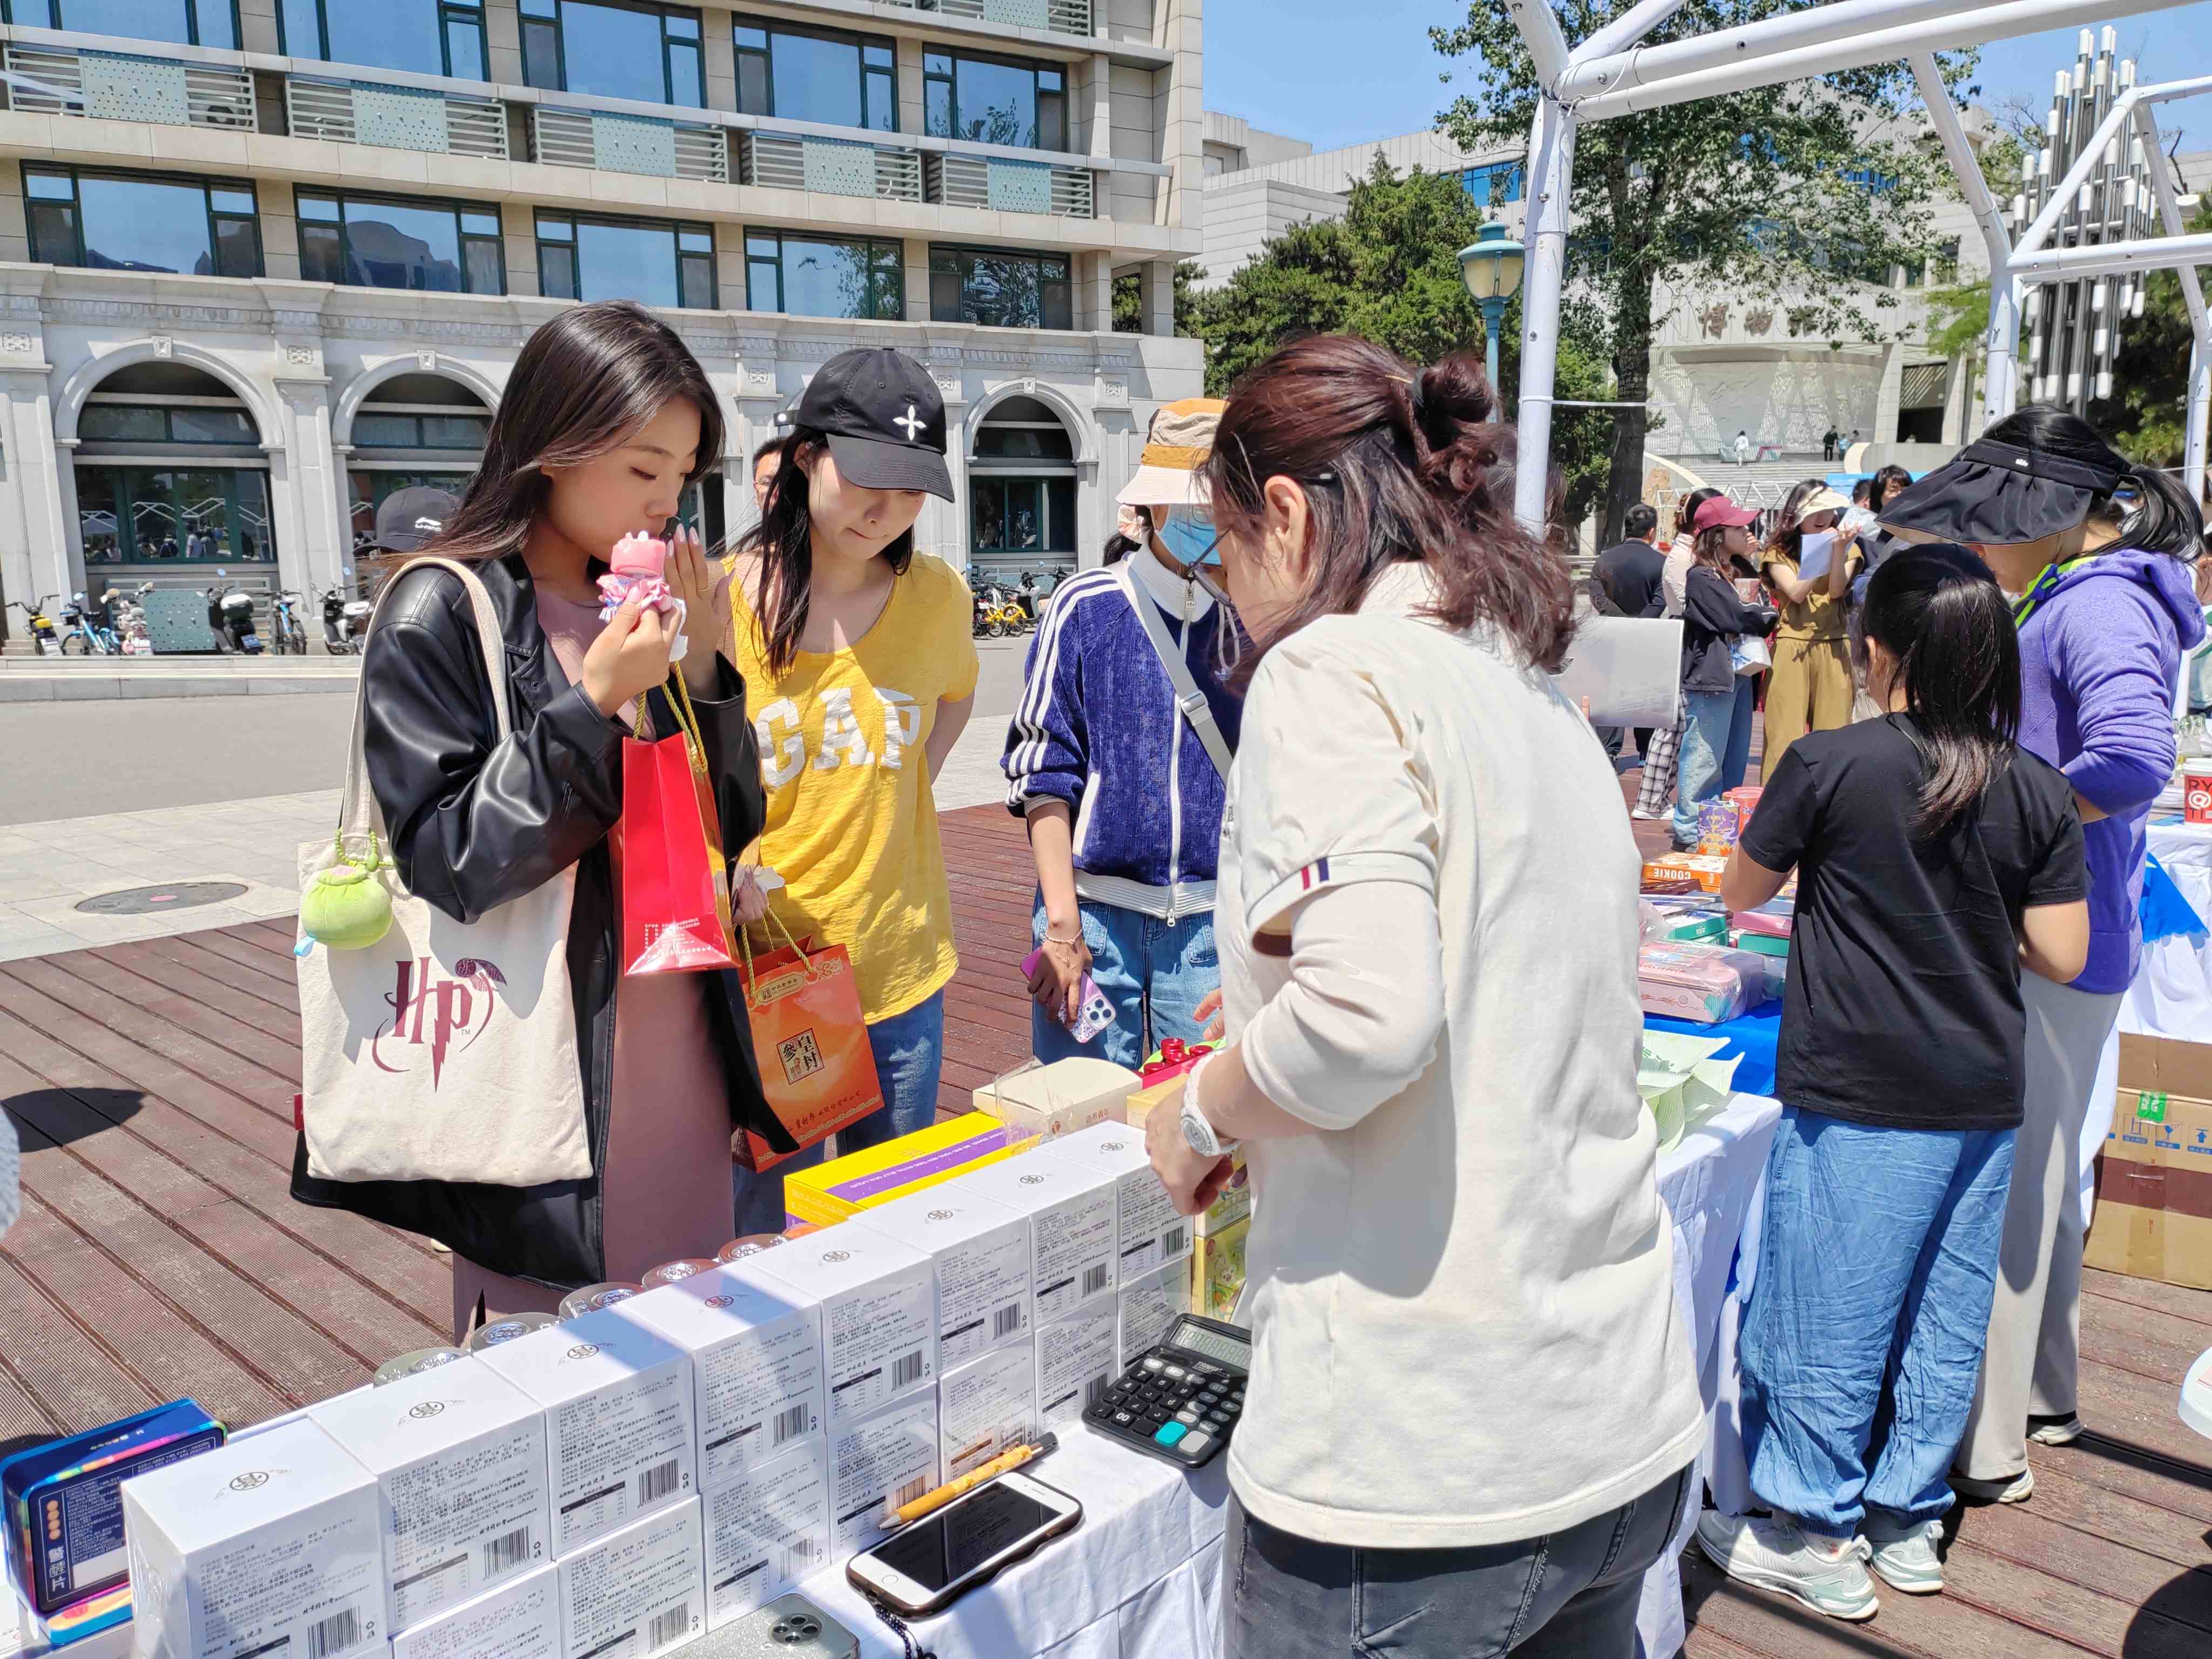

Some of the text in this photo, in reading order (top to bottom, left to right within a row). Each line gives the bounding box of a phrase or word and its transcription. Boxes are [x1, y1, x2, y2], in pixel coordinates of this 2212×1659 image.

[754, 687, 921, 787] GAP
[1653, 868, 1691, 880] COOKIE
[1116, 1412, 1130, 1422] 00
